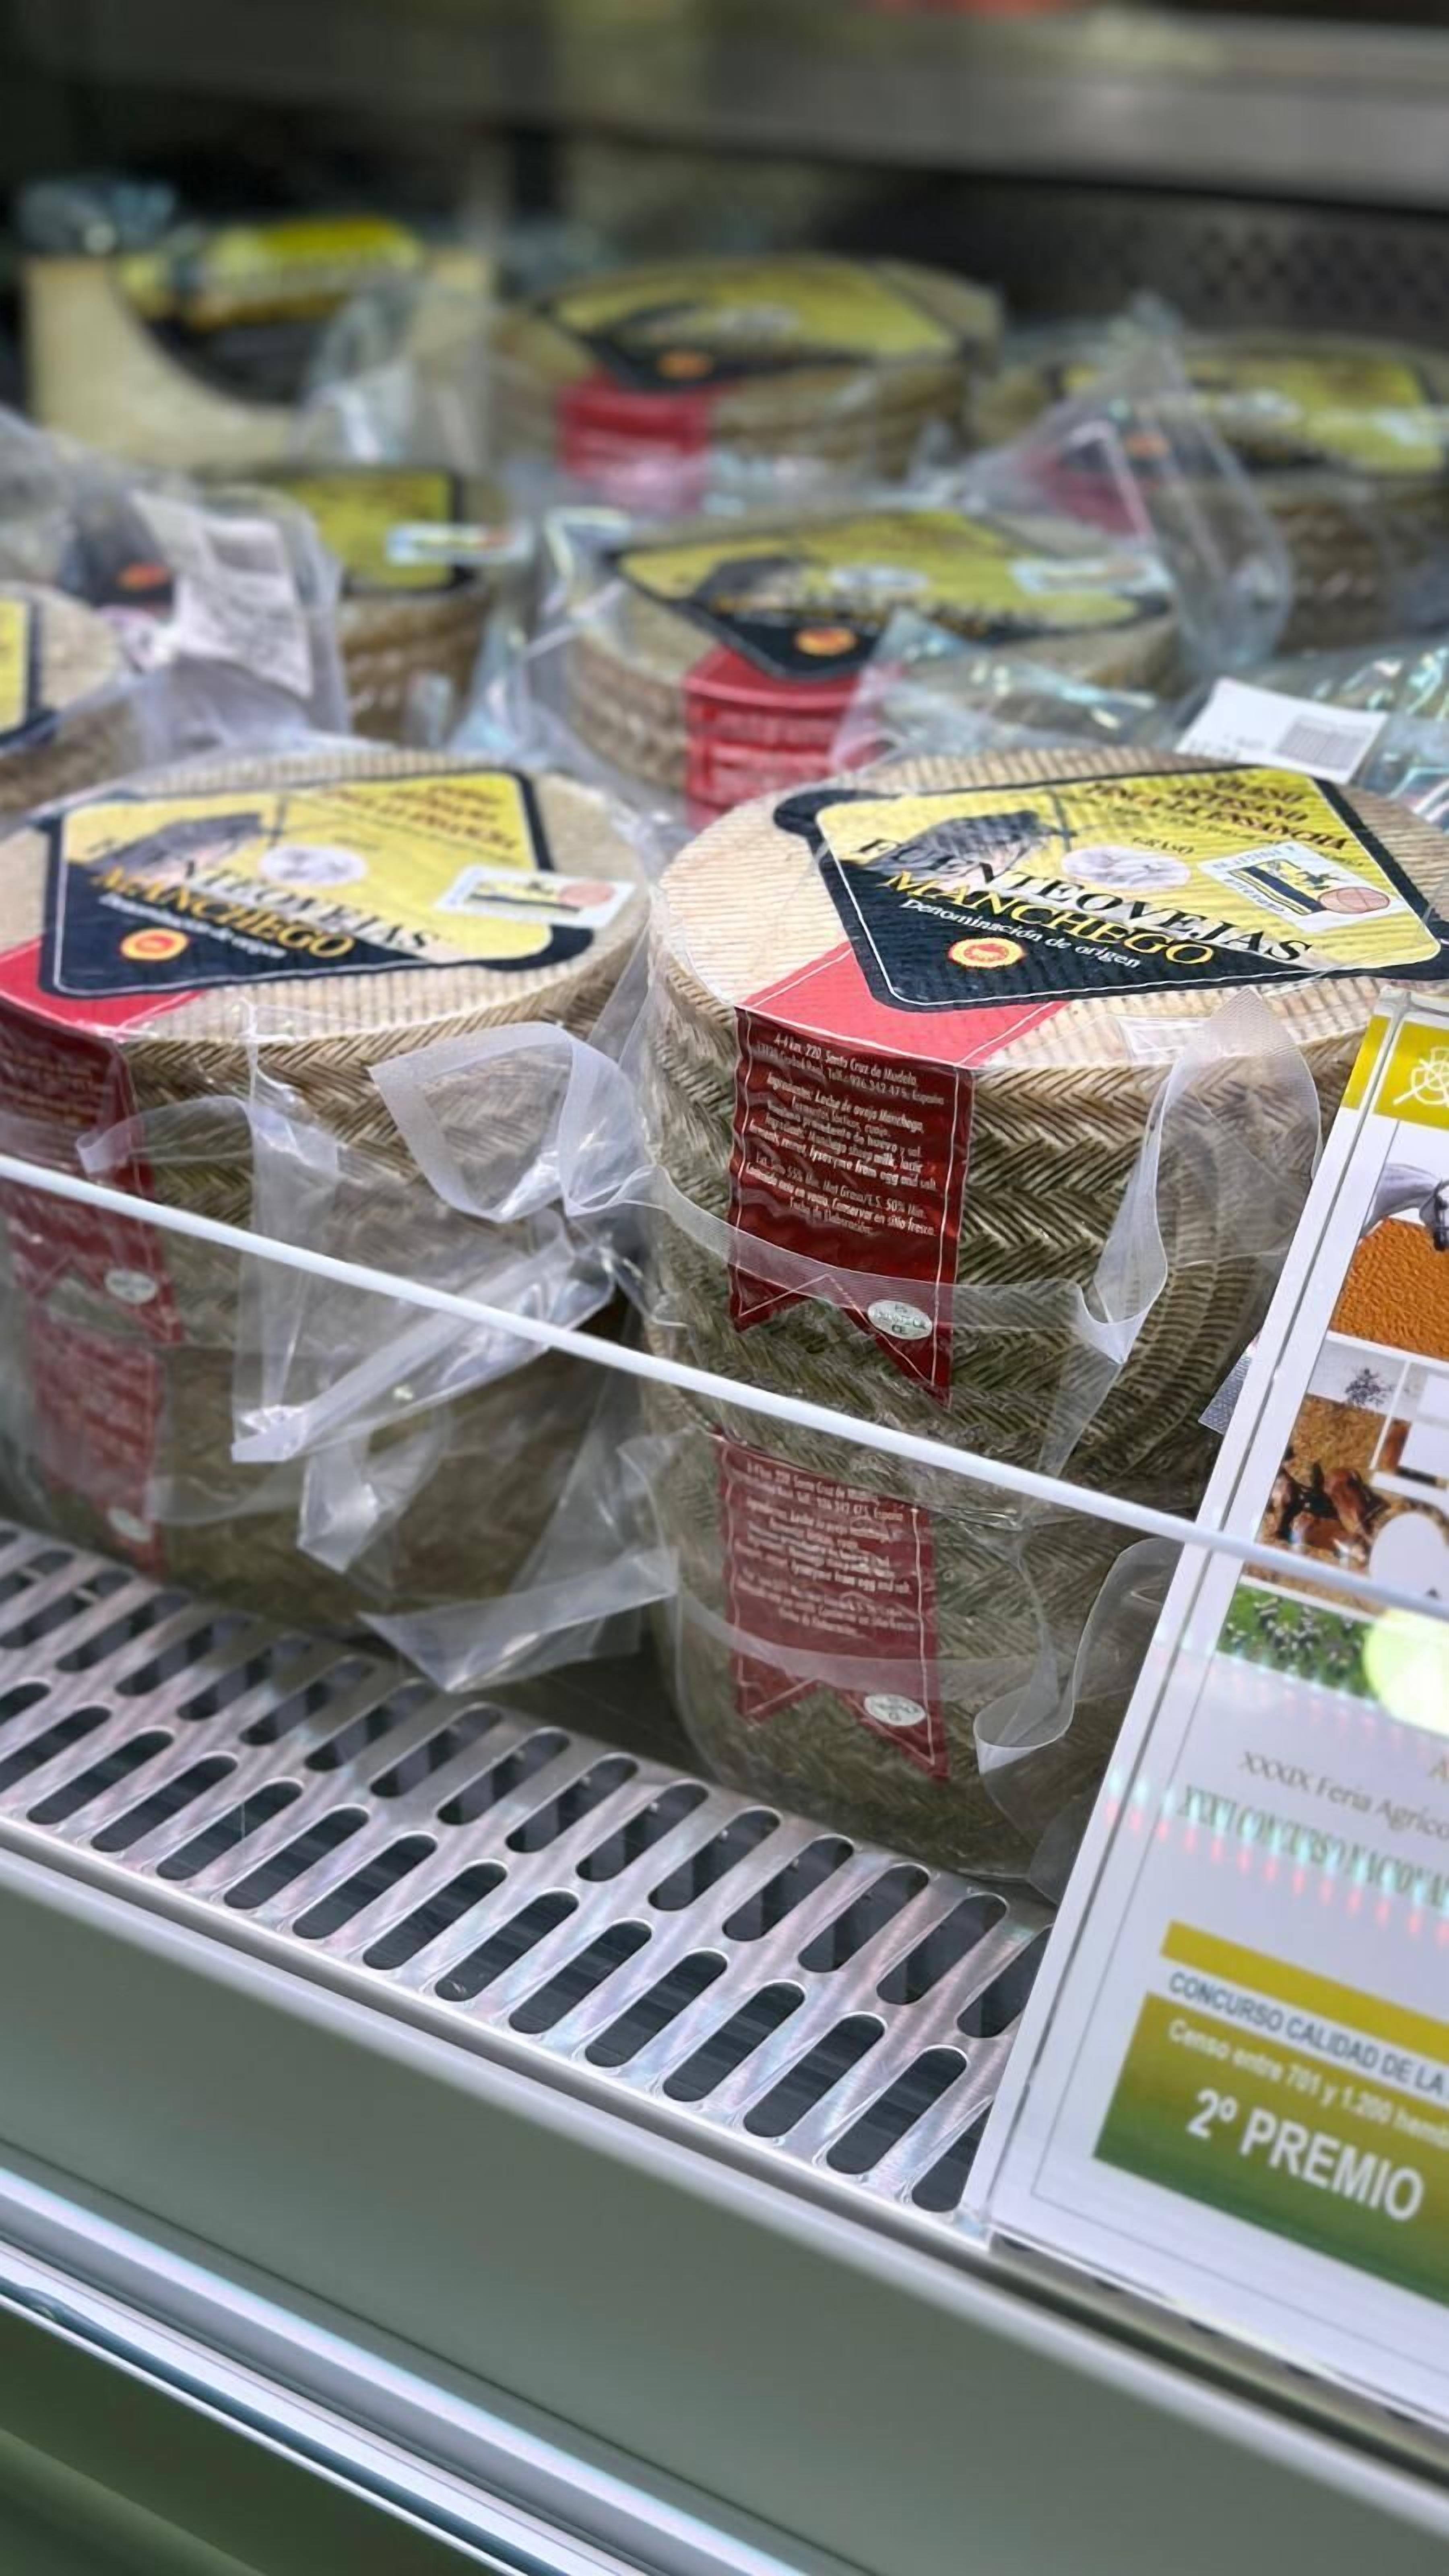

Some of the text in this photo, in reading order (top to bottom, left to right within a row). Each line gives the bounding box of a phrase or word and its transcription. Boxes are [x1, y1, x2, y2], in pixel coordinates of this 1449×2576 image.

[92, 866, 355, 957] MANCHEGO
[857, 838, 1312, 961] FUENTEOVEJAS
[876, 870, 1214, 964] MANCHEGO
[900, 899, 1141, 968] Denominación de origen
[850, 1059, 869, 1072] Cruz
[871, 1065, 881, 1076] de
[815, 1091, 840, 1106] Leche
[842, 1096, 852, 1111] de
[853, 1104, 877, 1121] oveja
[853, 1132, 865, 1143] de
[856, 1160, 877, 1175] from
[880, 1171, 898, 1184] egg
[902, 1172, 918, 1185] and
[832, 1199, 873, 1219] Conservar
[874, 1214, 884, 1222] en
[887, 1215, 906, 1229] sitio
[886, 1199, 905, 1213] 50%
[1240, 1750, 1311, 1793] XXXIX
[1316, 1774, 1372, 1814] Feria
[1169, 1971, 1443, 2096] CONCURSO CALIDAD DE LA
[1169, 2017, 1230, 2062] Censo
[1186, 2088, 1424, 2223] 2º PREMIO
